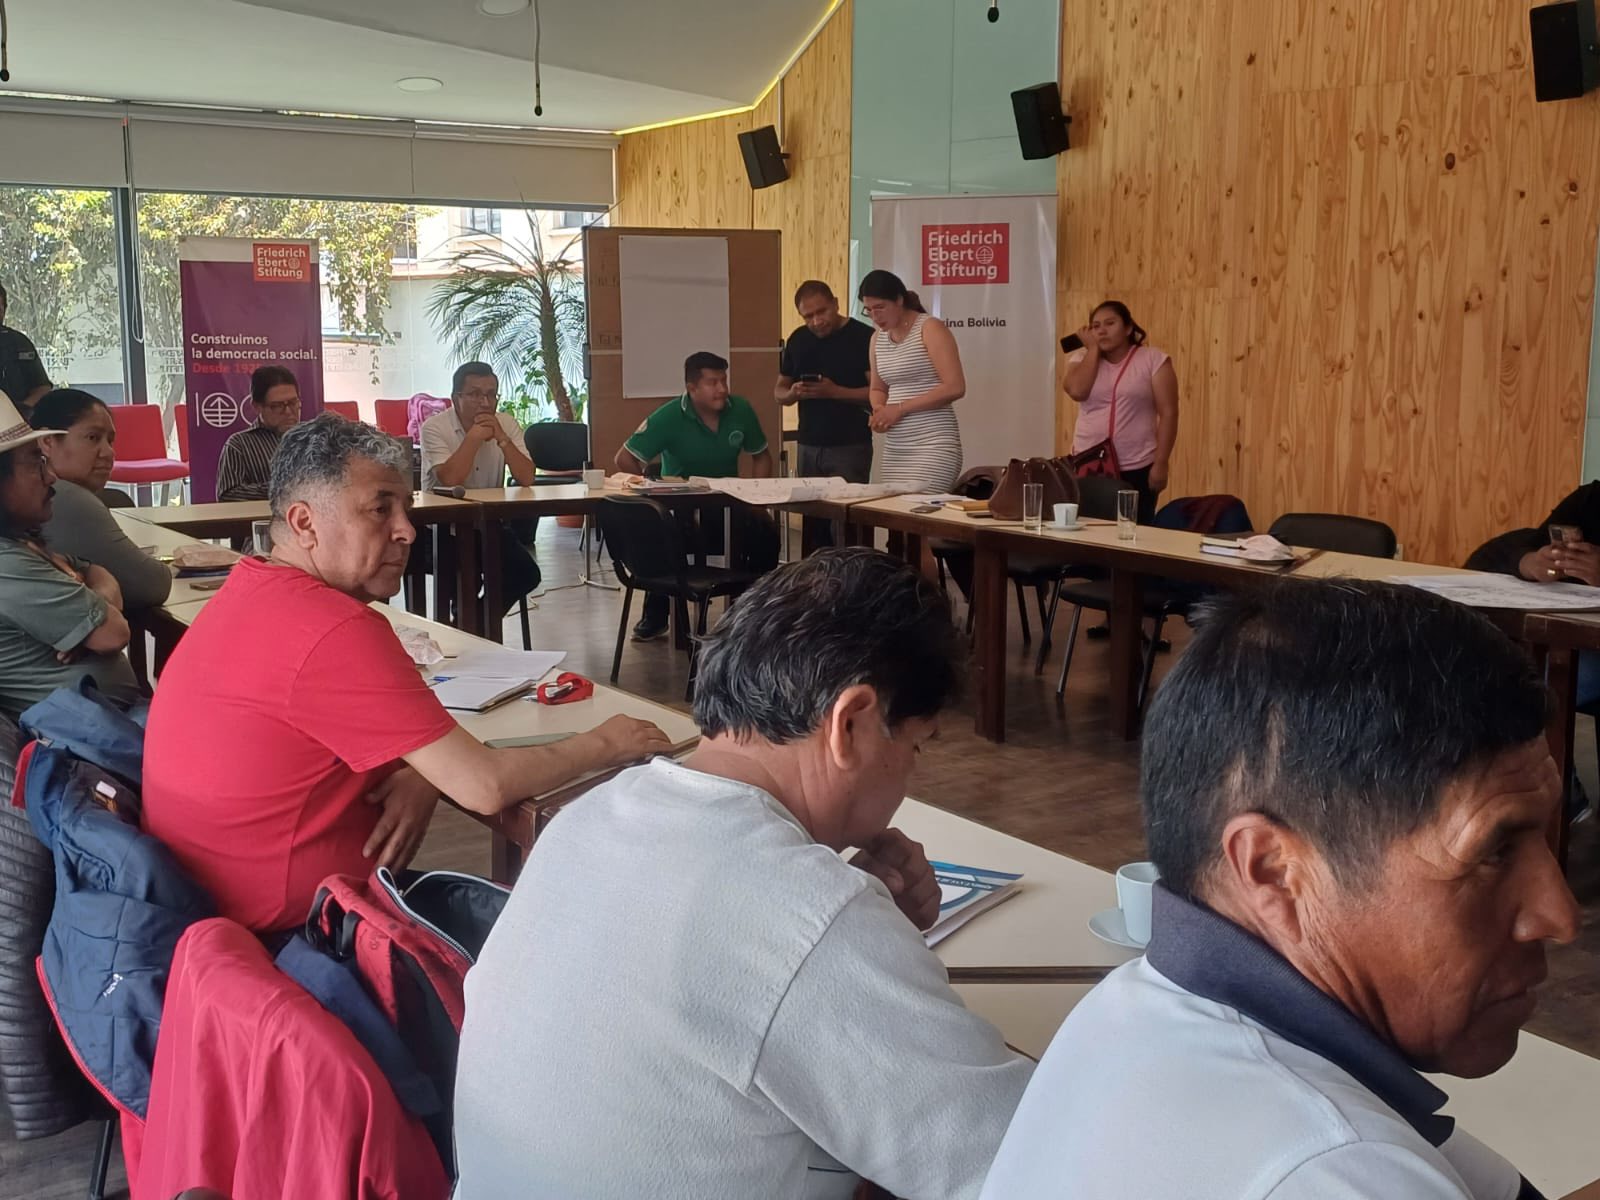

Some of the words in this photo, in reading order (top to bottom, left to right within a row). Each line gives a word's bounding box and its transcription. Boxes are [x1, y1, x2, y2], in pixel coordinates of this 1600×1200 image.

[928, 229, 1003, 246] Friedrich
[256, 247, 306, 258] Friedrich
[928, 246, 974, 261] Ebert
[257, 257, 287, 267] Ebert
[257, 267, 303, 280] Stiftung
[928, 262, 998, 280] Stiftung
[944, 318, 964, 328] ina
[967, 316, 1006, 328] Bolivia
[191, 333, 268, 345] Construimos
[191, 348, 203, 359] la
[206, 347, 277, 360] democracia
[279, 349, 318, 360] social.
[192, 362, 230, 374] Desde
